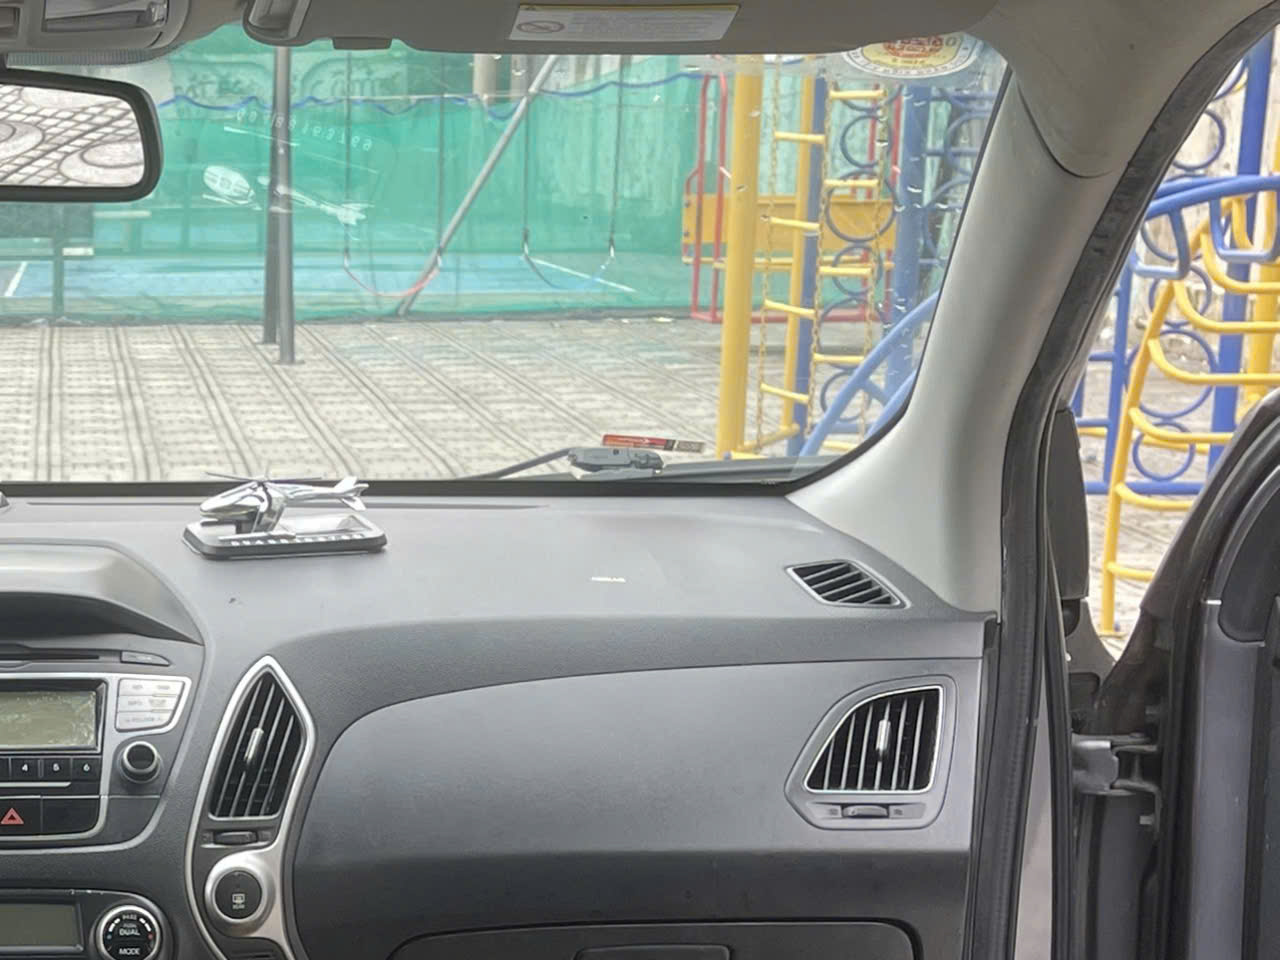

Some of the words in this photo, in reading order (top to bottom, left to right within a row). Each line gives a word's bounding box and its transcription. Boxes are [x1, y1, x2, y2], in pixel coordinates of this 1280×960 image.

[21, 763, 29, 772] 4
[52, 763, 60, 772] 5
[83, 763, 90, 772] 6
[119, 928, 140, 936] DUAL
[119, 947, 140, 955] MODE
